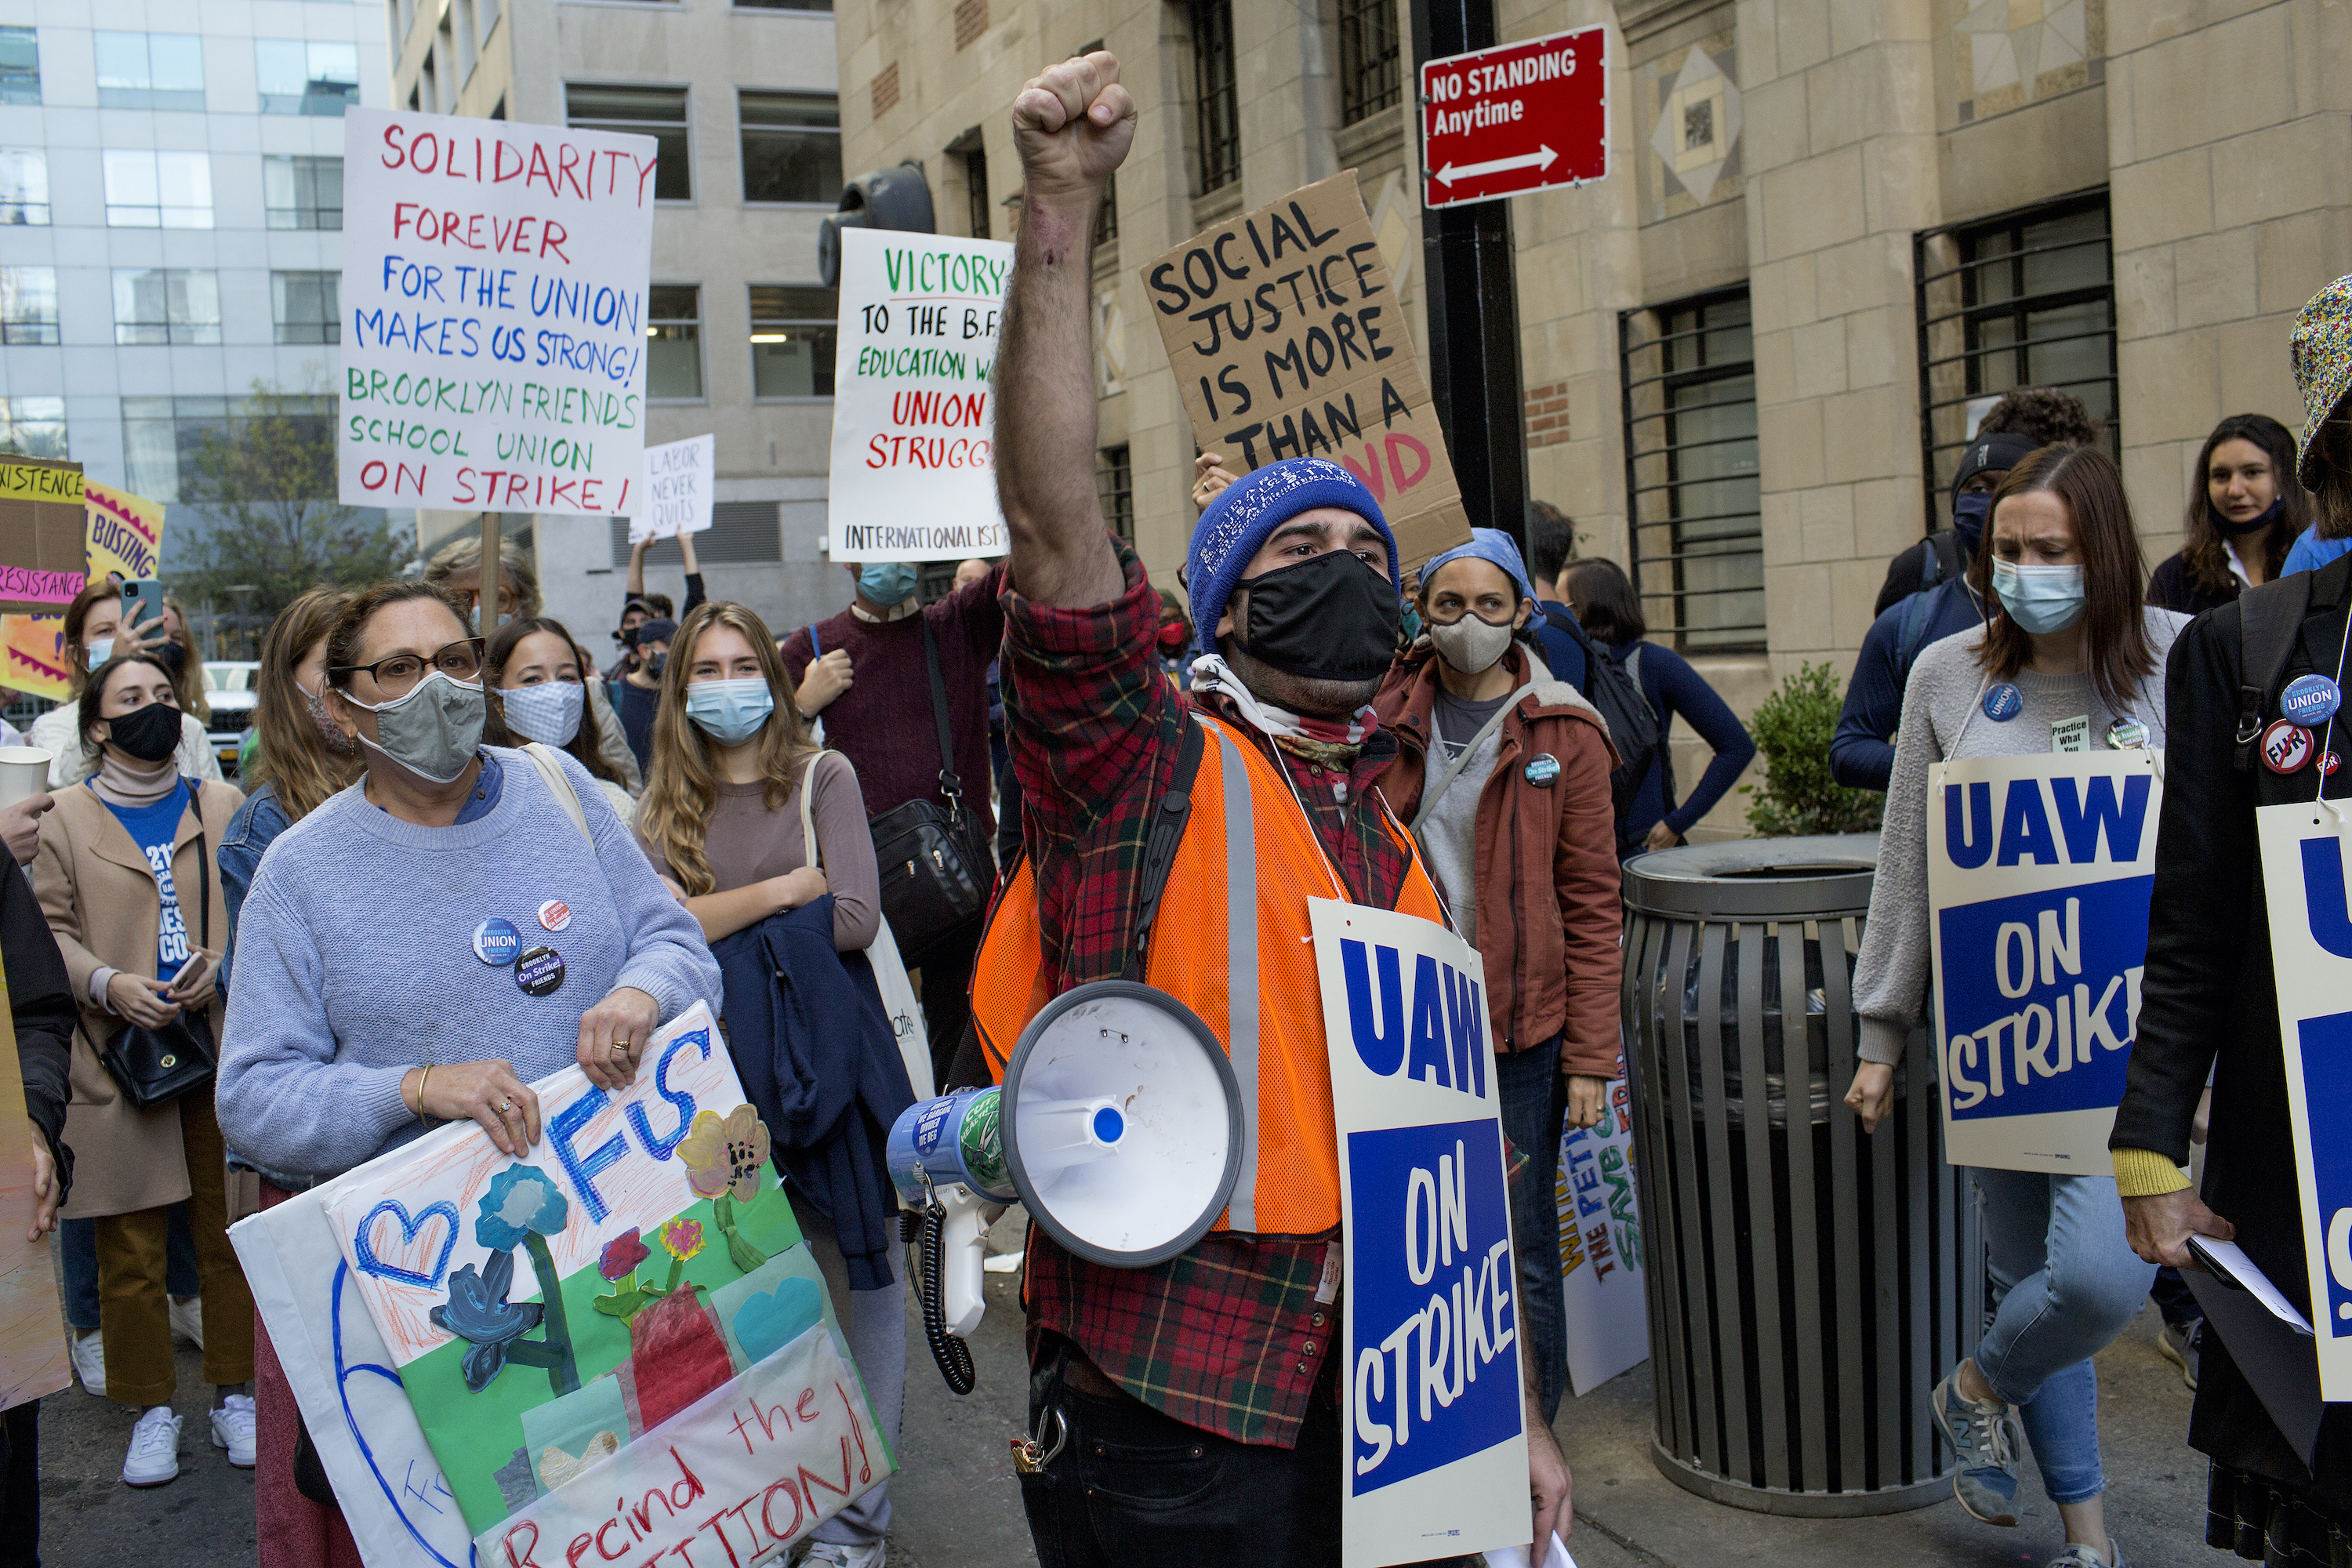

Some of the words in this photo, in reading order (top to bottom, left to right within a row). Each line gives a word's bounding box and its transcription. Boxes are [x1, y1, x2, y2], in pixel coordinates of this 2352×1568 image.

[1432, 73, 1462, 103] NO
[1468, 48, 1576, 96] STANDING
[1434, 99, 1523, 136] Anytime
[382, 125, 657, 208] SOLIDARITY
[394, 202, 570, 264] FOREVER
[885, 248, 1006, 296] VICTORY
[1149, 201, 1340, 315] SOCIAL
[383, 256, 445, 303] FOR
[455, 266, 517, 309] THE
[531, 274, 639, 336] UNION
[1189, 241, 1385, 356] JUSTICE
[862, 304, 889, 334] TO
[907, 306, 948, 336] THE
[355, 308, 481, 357] MAKES
[492, 325, 525, 362] US
[536, 330, 639, 388] STRONG!
[858, 346, 965, 380] EDUCATION
[1200, 365, 1251, 422] IS
[1265, 306, 1394, 400] MORE
[348, 367, 512, 414] BROOKLYN
[523, 382, 640, 429] FRIENDS
[892, 390, 985, 427] UNION
[1225, 392, 1362, 471] THAN
[1381, 377, 1412, 430] A
[350, 416, 468, 456] SCHOOL
[497, 433, 593, 472] UNION
[650, 442, 700, 475] LABOR
[866, 434, 994, 470] STRUGG
[361, 460, 426, 496] ON
[652, 473, 696, 502] NEVER
[652, 499, 693, 527] QUITS
[92, 513, 157, 579] BUSTING
[846, 524, 1000, 550] INTERNATIONALIST
[1991, 687, 2013, 715] UNION
[2288, 689, 2332, 710] UNION
[2292, 684, 2325, 697] BROOKLYN
[2298, 702, 2325, 714] FRIENDS
[2052, 721, 2086, 735] Practice
[2060, 733, 2081, 745] What
[2267, 730, 2306, 766] FUR
[1945, 774, 2153, 870] UAW
[480, 935, 516, 947] UNION
[1995, 897, 2082, 999] ON
[518, 973, 532, 982] On
[533, 958, 561, 976] Strike!
[521, 953, 550, 970] BROOKLYN
[531, 972, 556, 987] FRIENDS
[1339, 937, 1485, 1099] UAW
[917, 1113, 928, 1124] WE
[920, 1116, 941, 1134] DIVIDED
[919, 1134, 927, 1147] WE
[927, 1129, 937, 1143] BEG
[1405, 1139, 1468, 1285] ON
[1586, 1222, 1615, 1283] THE
[1356, 1238, 1514, 1477] STRIKE
[502, 1445, 706, 1568] Recind
[728, 1387, 819, 1456] the
